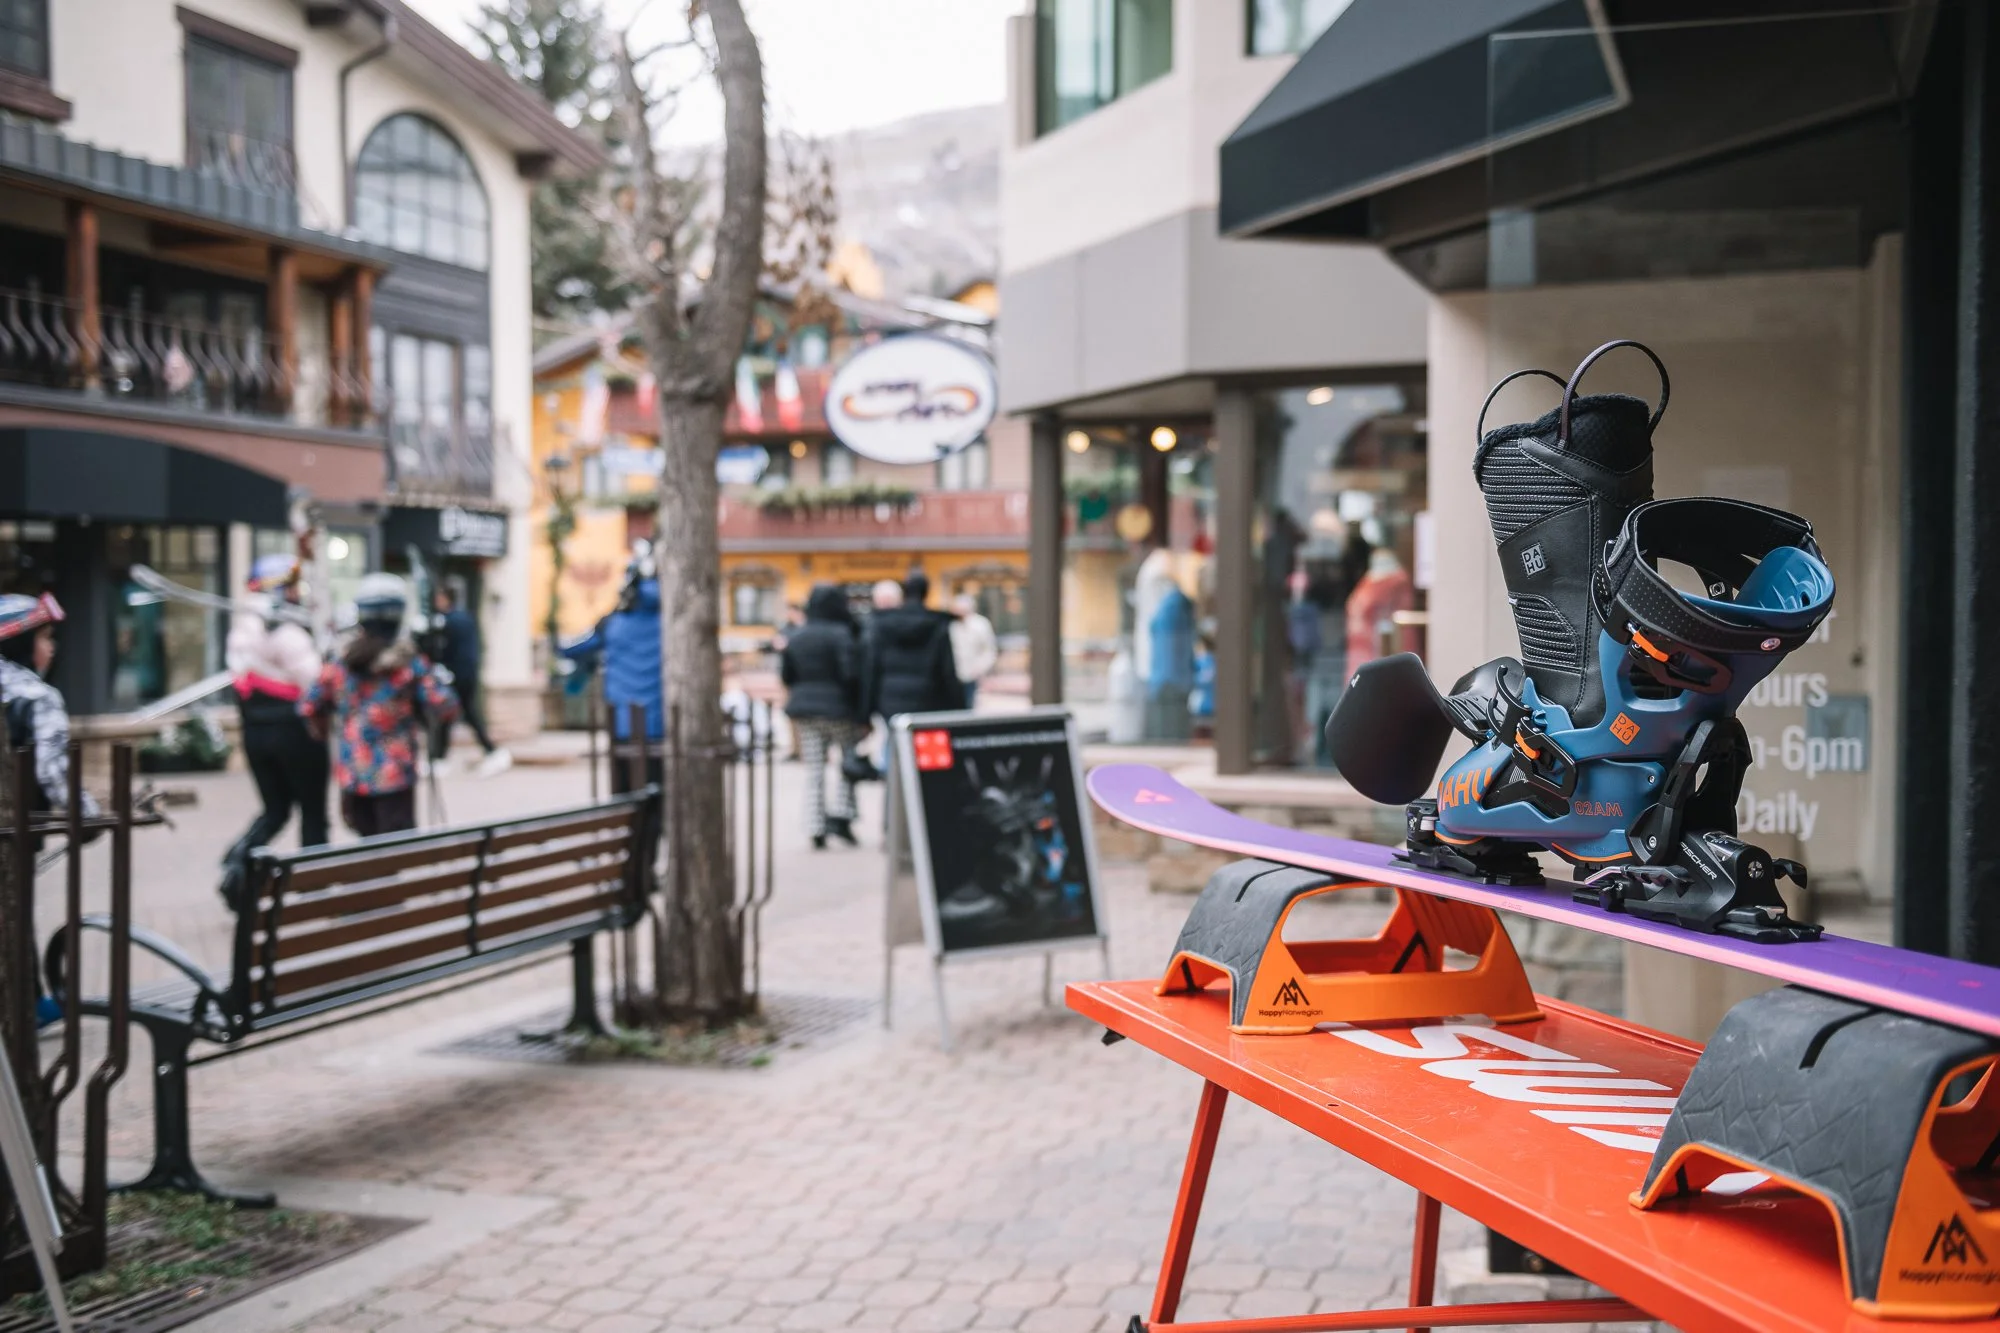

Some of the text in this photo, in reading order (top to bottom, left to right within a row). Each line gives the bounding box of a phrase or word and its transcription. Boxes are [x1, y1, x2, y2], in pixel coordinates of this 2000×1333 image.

[1740, 673, 1828, 707] ours
[1574, 800, 1623, 817] 02AM
[1680, 841, 1718, 880] FISCHER
